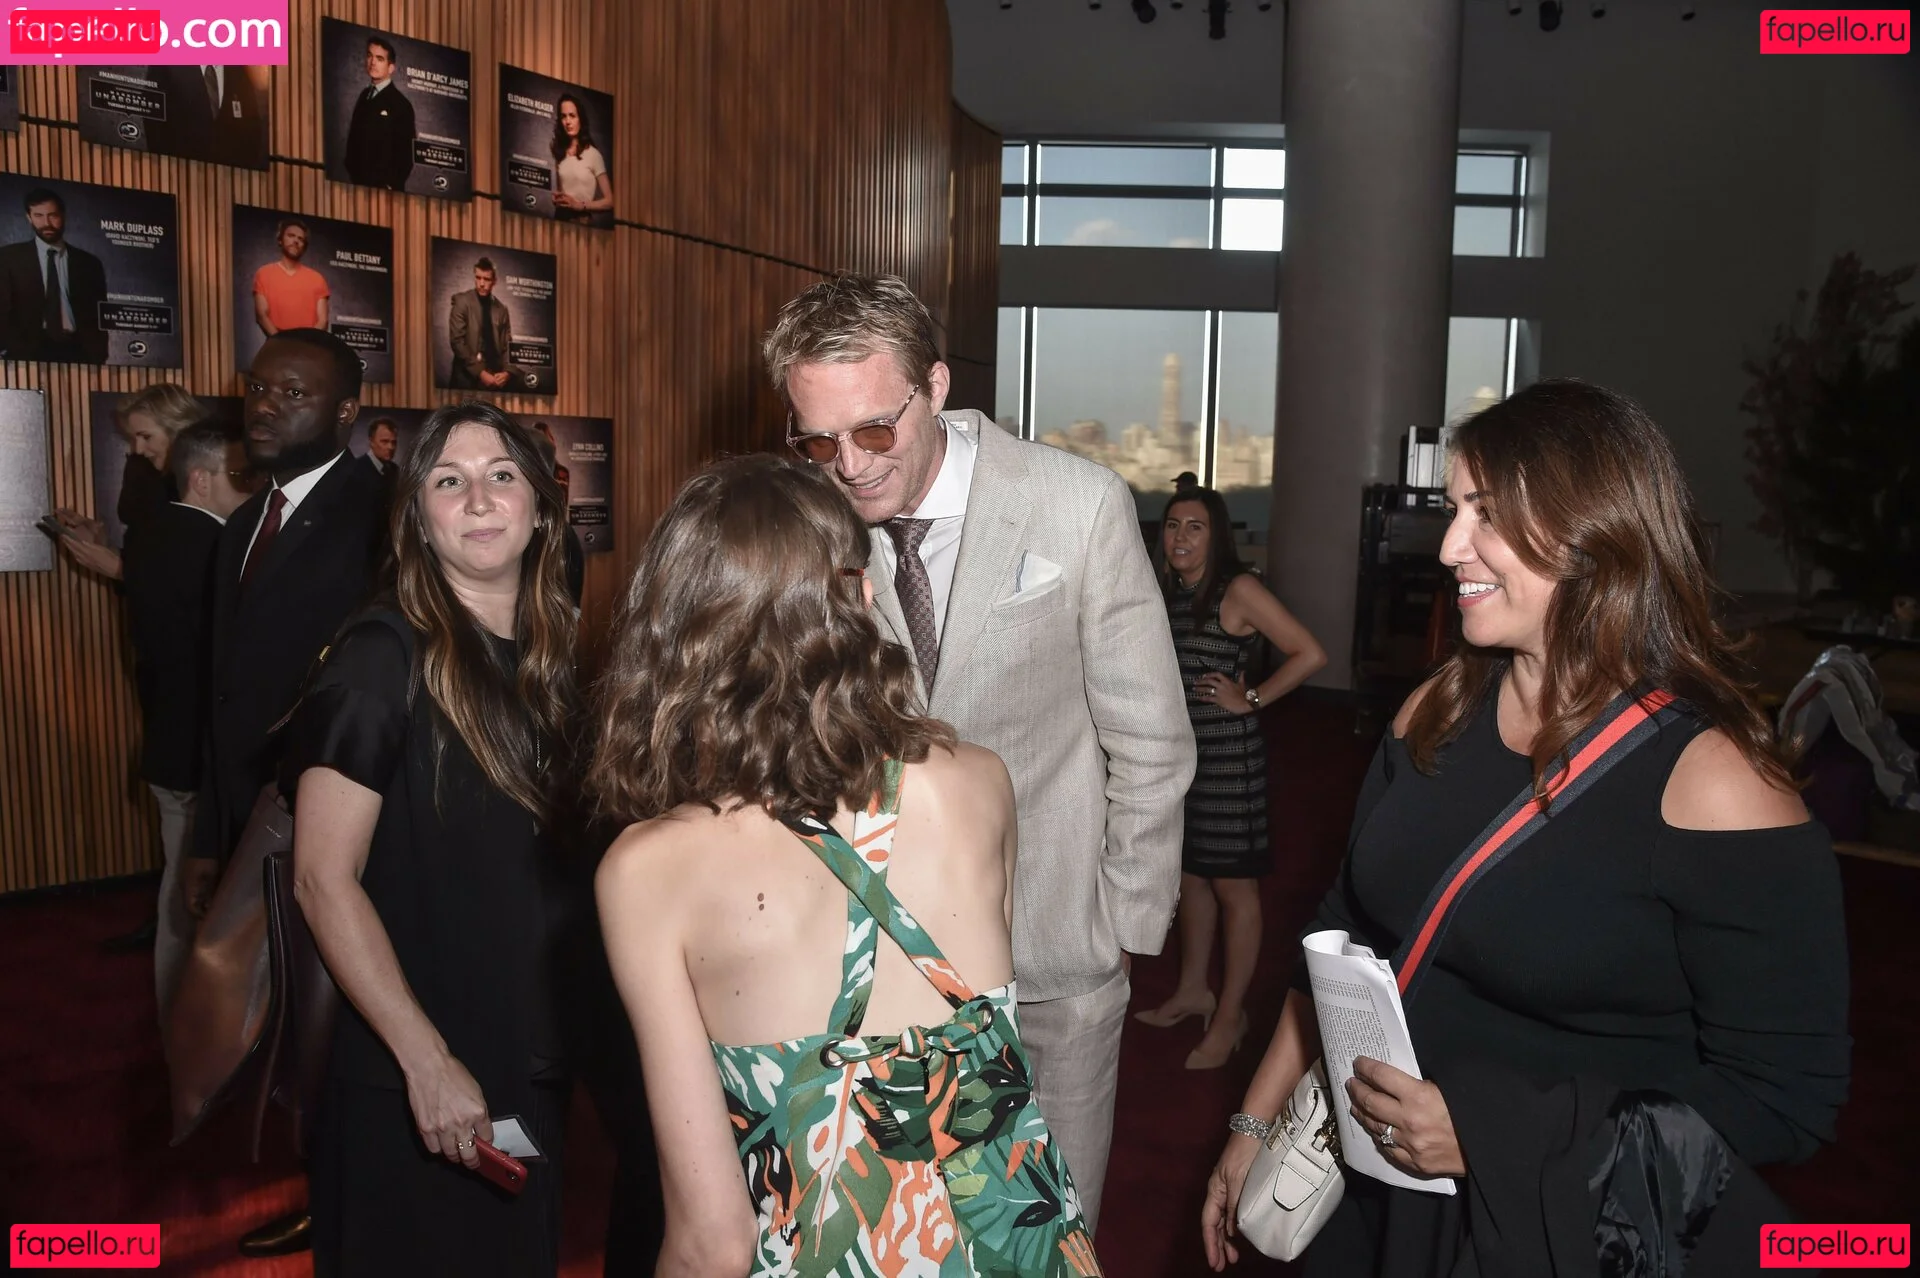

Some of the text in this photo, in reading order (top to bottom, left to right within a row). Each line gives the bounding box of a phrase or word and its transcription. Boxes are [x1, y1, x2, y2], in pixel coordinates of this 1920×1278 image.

[406, 67, 425, 79] BRIAN
[427, 71, 447, 83] D'ARCY
[449, 76, 469, 88] JAMES
[100, 220, 164, 236] MARK DUPLASS
[336, 250, 381, 265] PAUL BETTANY
